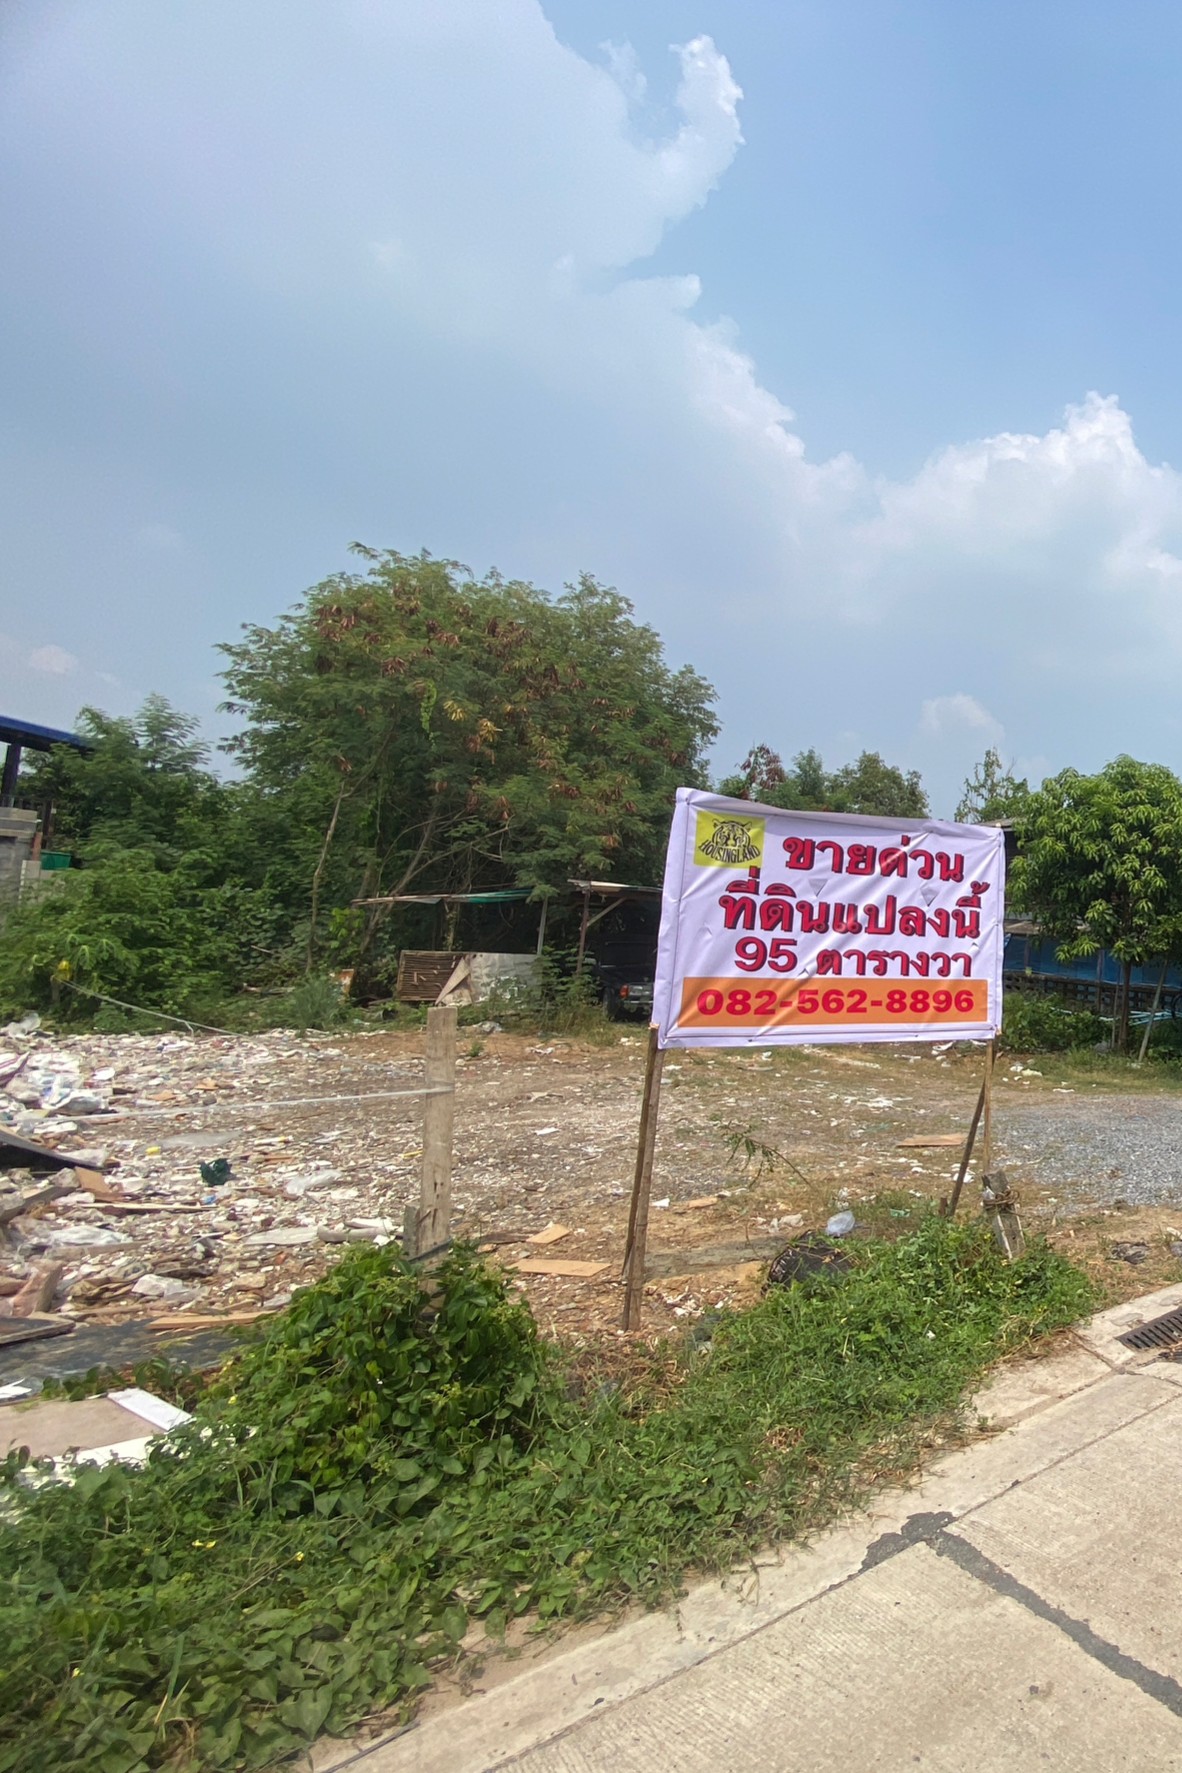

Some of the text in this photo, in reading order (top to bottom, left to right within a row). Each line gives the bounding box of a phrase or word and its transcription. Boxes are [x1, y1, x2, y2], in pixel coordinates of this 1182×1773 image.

[783, 834, 964, 882] ขายด่วน
[719, 866, 990, 939] ที่ดินแปลงนี้
[735, 937, 972, 977] 95 ตารางวา
[696, 988, 975, 1017] 082-562-8896
